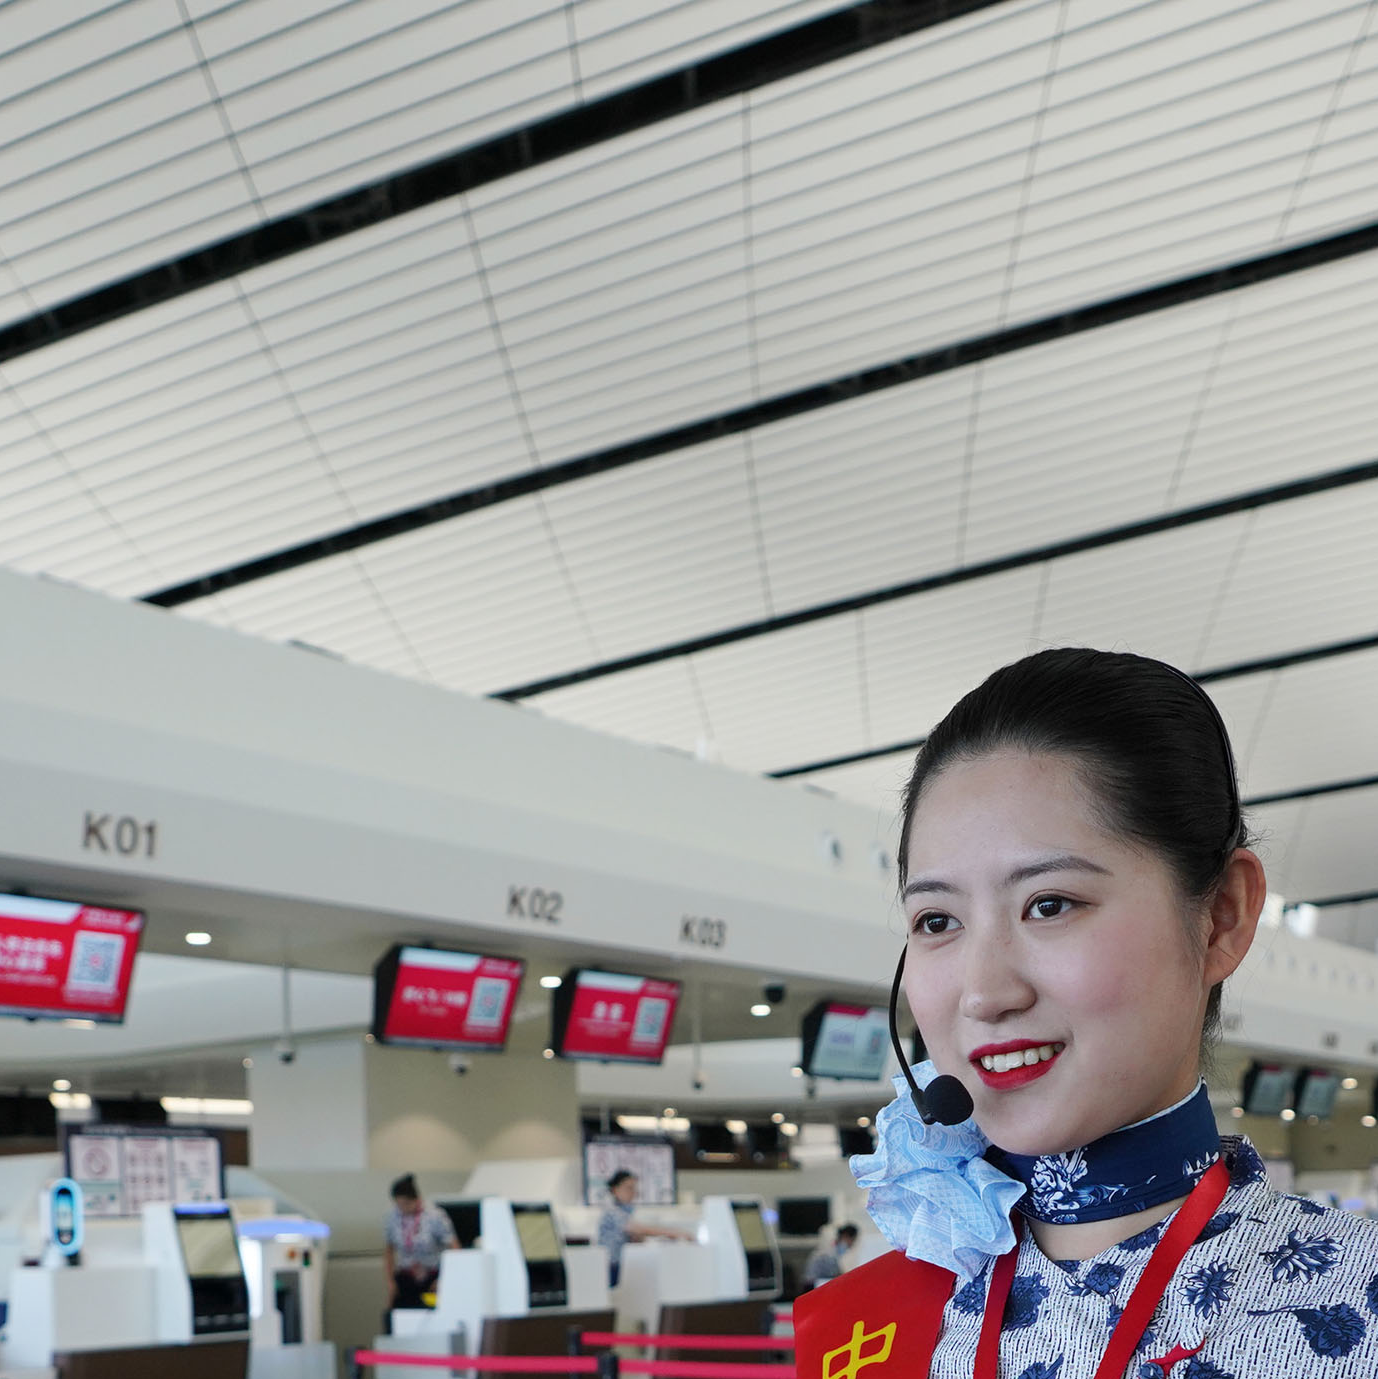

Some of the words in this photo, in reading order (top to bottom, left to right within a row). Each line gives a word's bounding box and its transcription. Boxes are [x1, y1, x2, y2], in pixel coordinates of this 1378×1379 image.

[82, 810, 157, 859] K01
[506, 885, 564, 925] K02
[679, 914, 727, 949] K03
